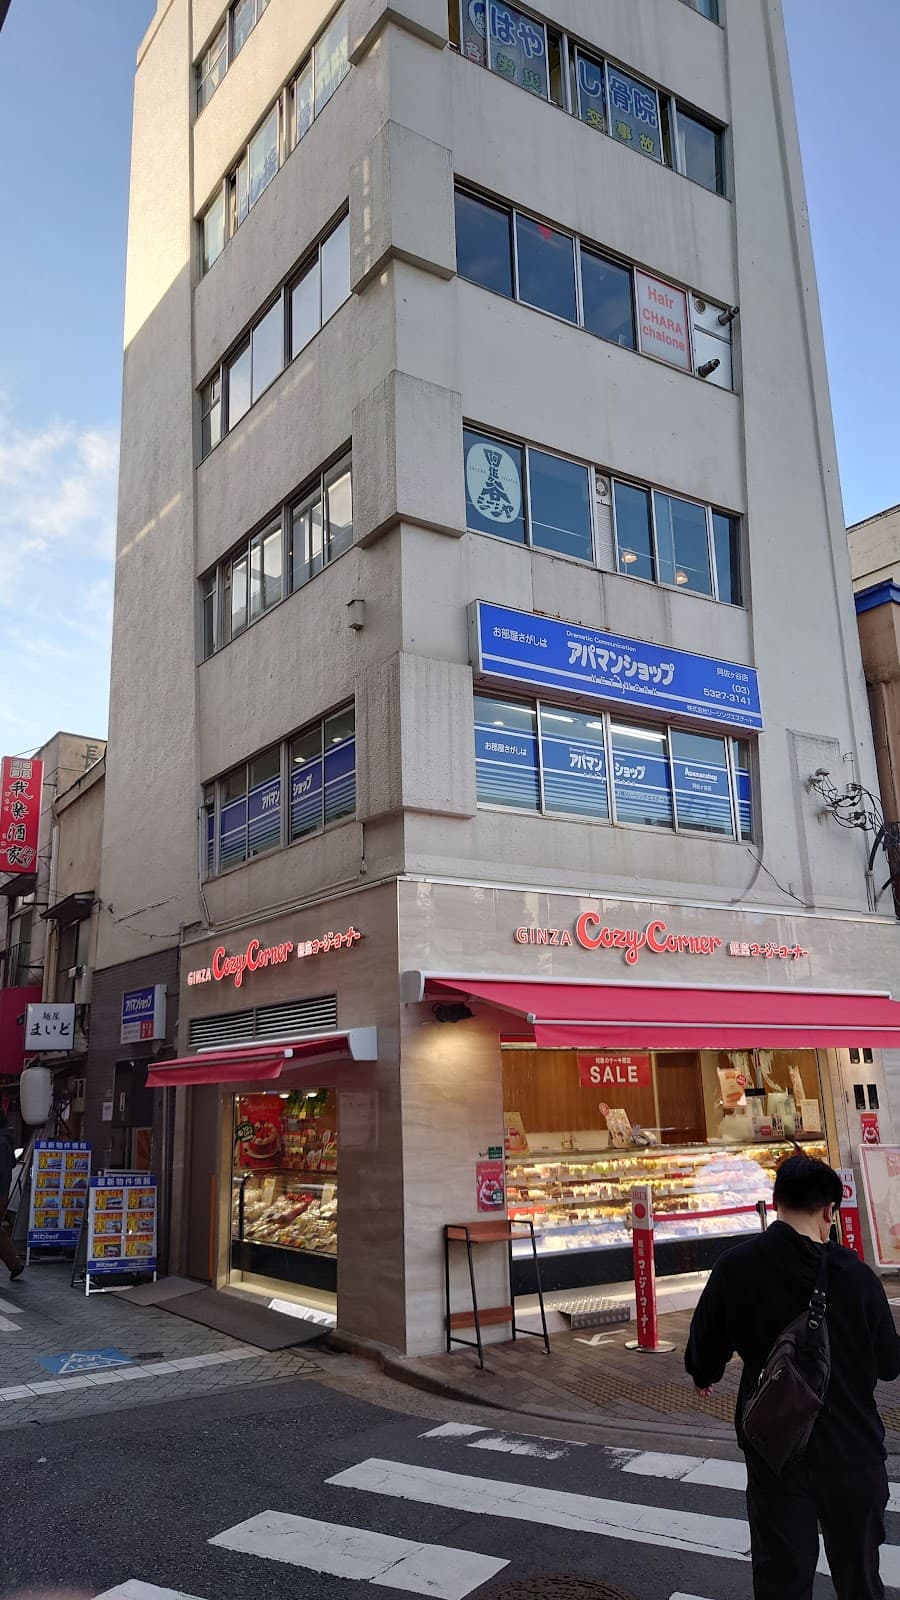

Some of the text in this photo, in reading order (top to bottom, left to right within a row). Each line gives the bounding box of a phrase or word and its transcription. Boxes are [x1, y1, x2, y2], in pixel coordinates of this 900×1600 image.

[648, 286, 674, 309] Hair
[643, 308, 683, 335] CHARA
[642, 325, 685, 351] chalone
[492, 626, 548, 648] お部屋さがしは
[566, 630, 636, 652] Dramatic Communication
[567, 641, 675, 686] アパマンショップ
[732, 684, 750, 696] (03)
[516, 927, 572, 945] GINZA
[575, 911, 646, 965] Cozy
[645, 920, 722, 954] Corner
[187, 967, 211, 987] GINZA
[212, 945, 248, 987] Cozy
[245, 938, 293, 972] Corner
[30, 1022, 71, 1036] まいど
[590, 1065, 639, 1083] SALE
